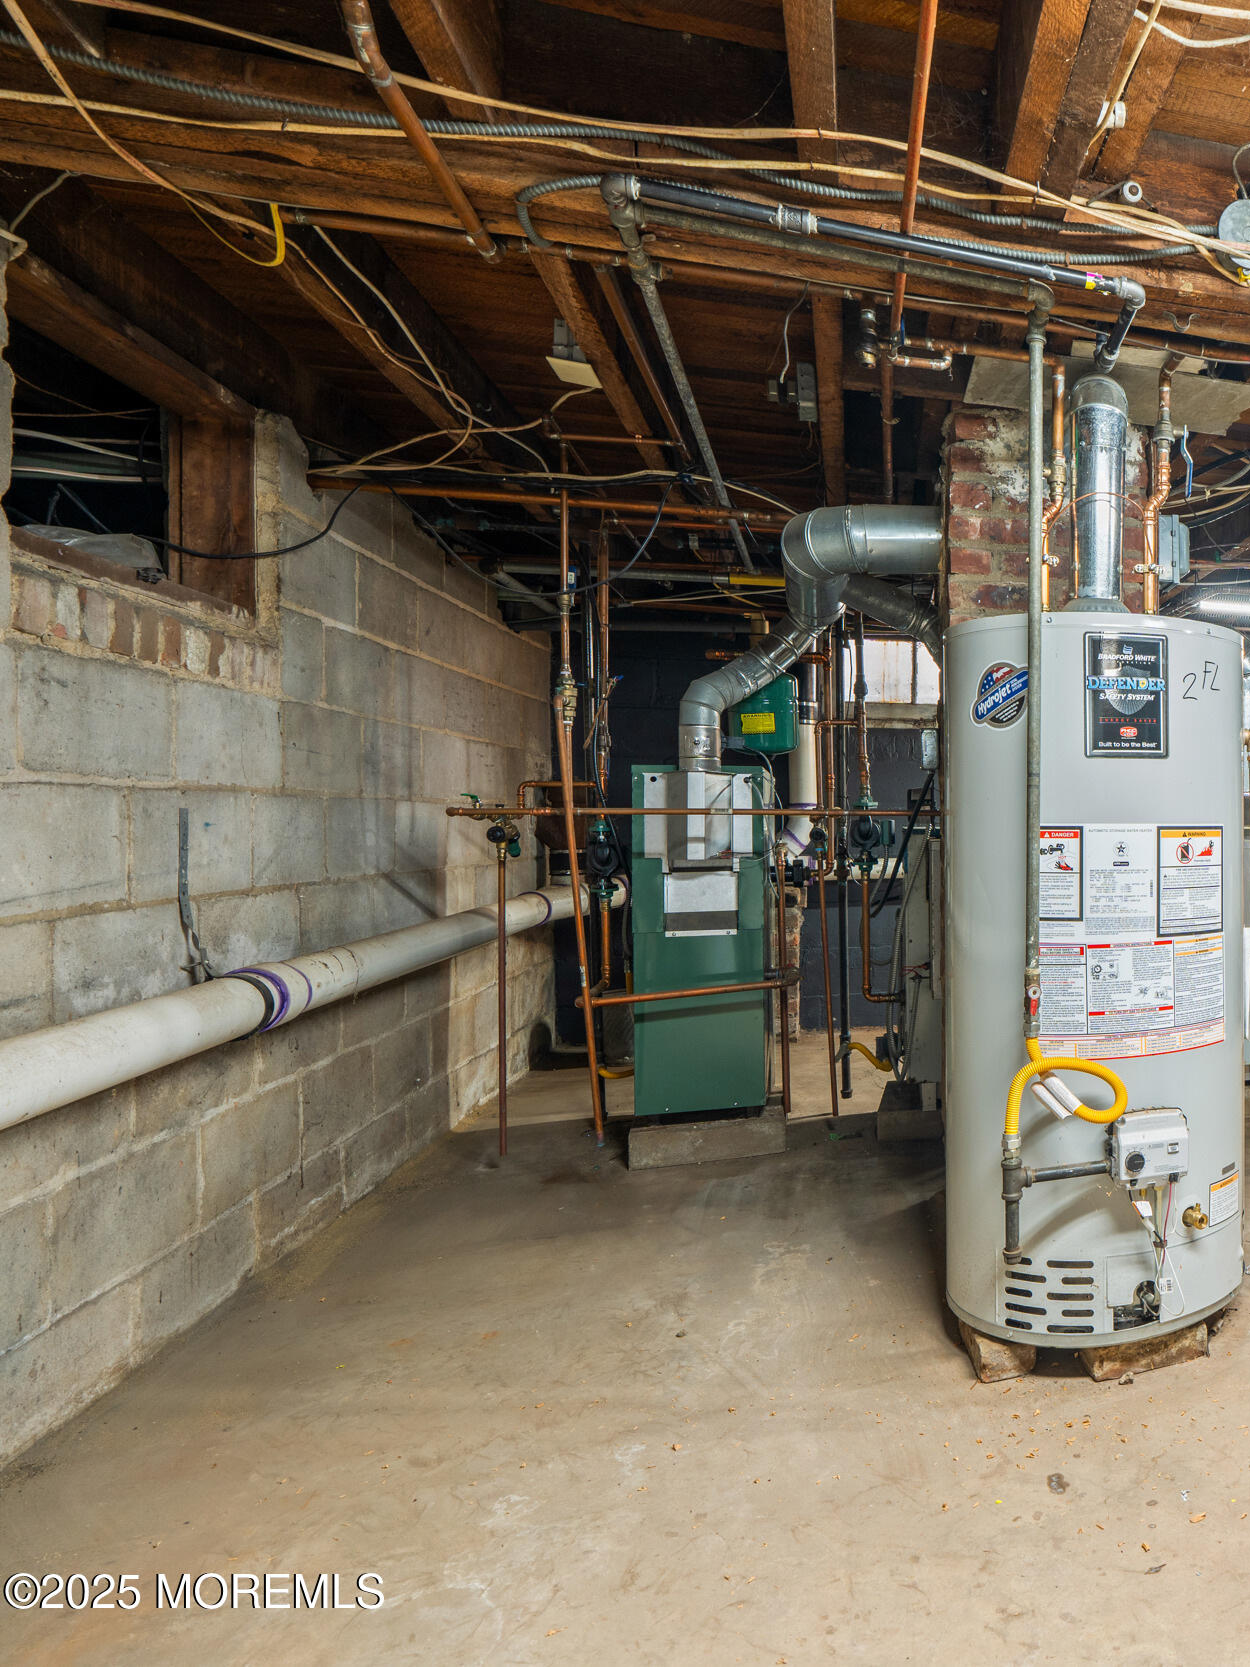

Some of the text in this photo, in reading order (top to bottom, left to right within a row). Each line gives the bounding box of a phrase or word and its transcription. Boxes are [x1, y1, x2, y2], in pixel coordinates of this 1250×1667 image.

[1087, 676, 1165, 691] DEFENDER
[1182, 661, 1221, 700] 2 FL
[978, 683, 1011, 715] Hydrojet
[1127, 693, 1155, 701] SYSTEM
